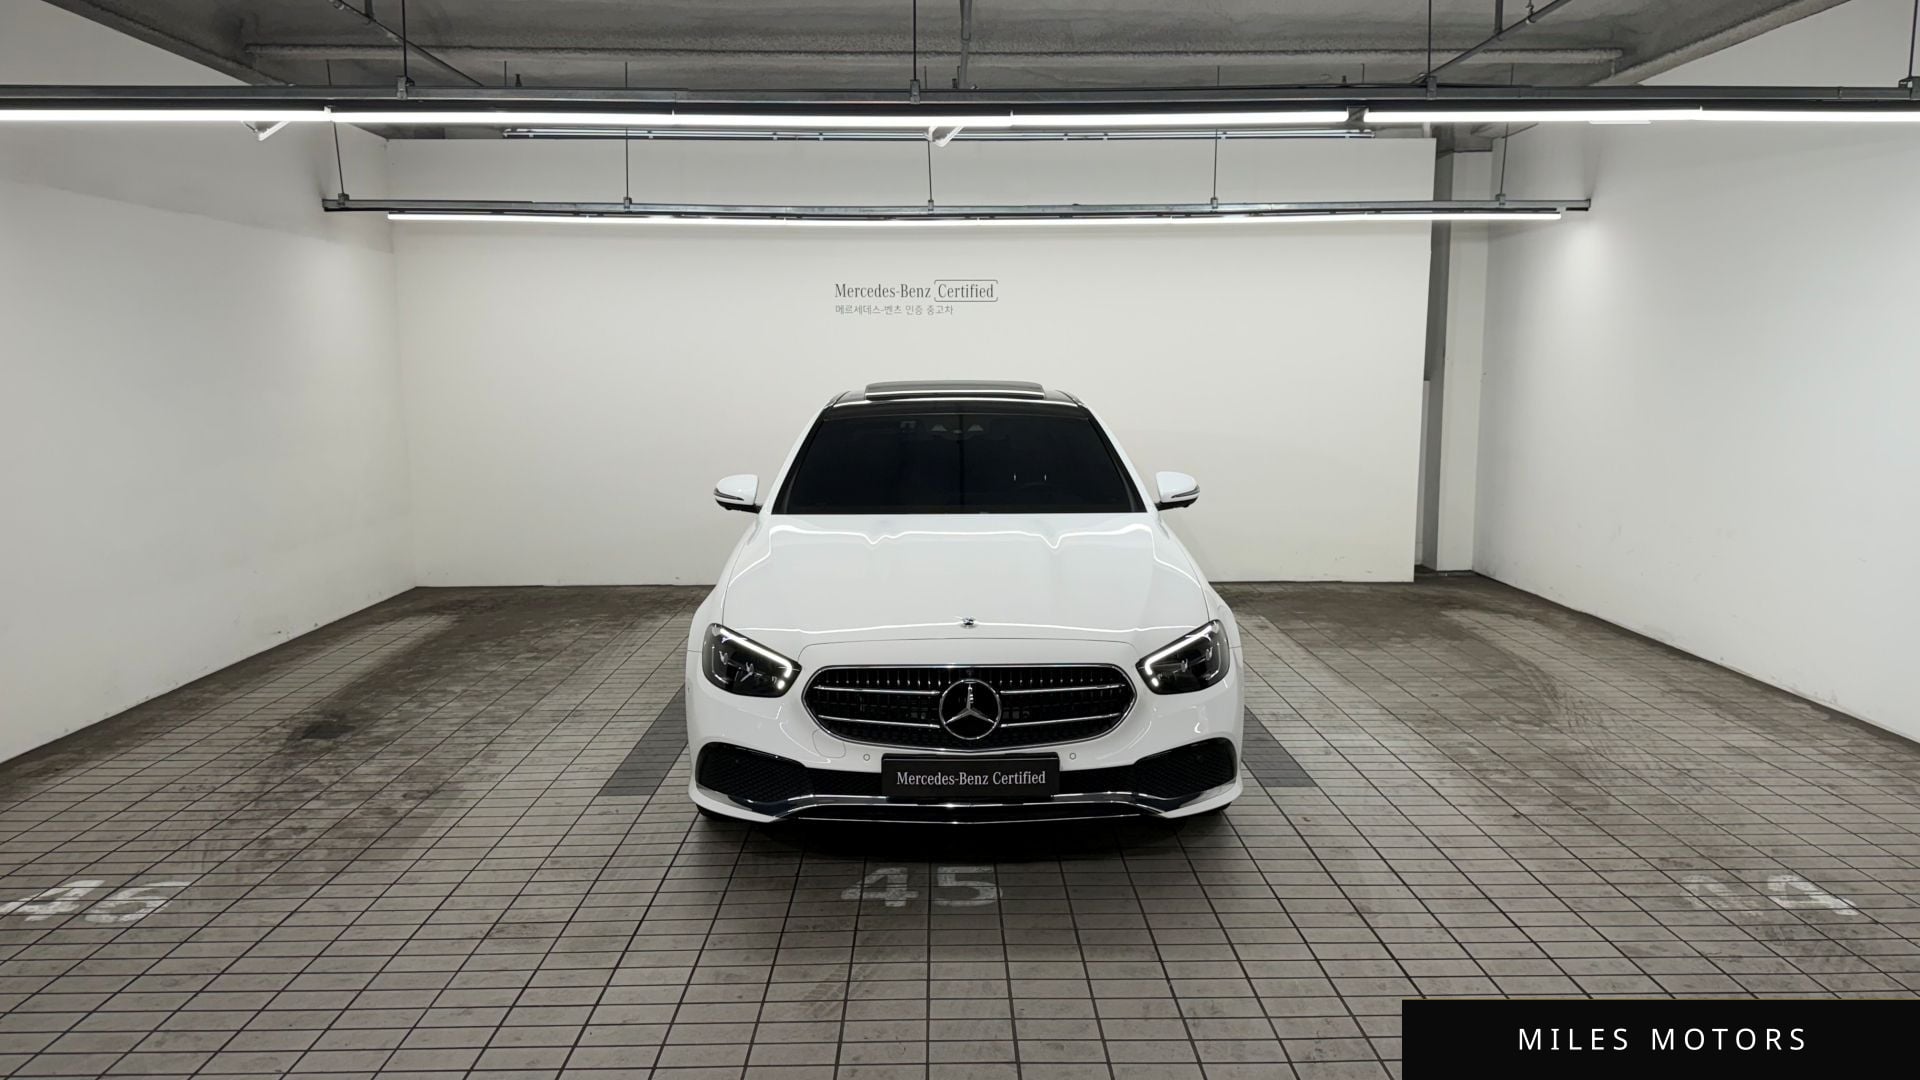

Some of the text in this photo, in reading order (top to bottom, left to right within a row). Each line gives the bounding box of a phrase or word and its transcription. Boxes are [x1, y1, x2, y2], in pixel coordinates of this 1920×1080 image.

[835, 283, 994, 299] Mercedes-Benz Certified
[835, 304, 954, 316] 메르세데스-벤츠 인증 중고차
[896, 770, 1047, 786] Mercedes-Benz Certified
[841, 866, 1004, 908] 45
